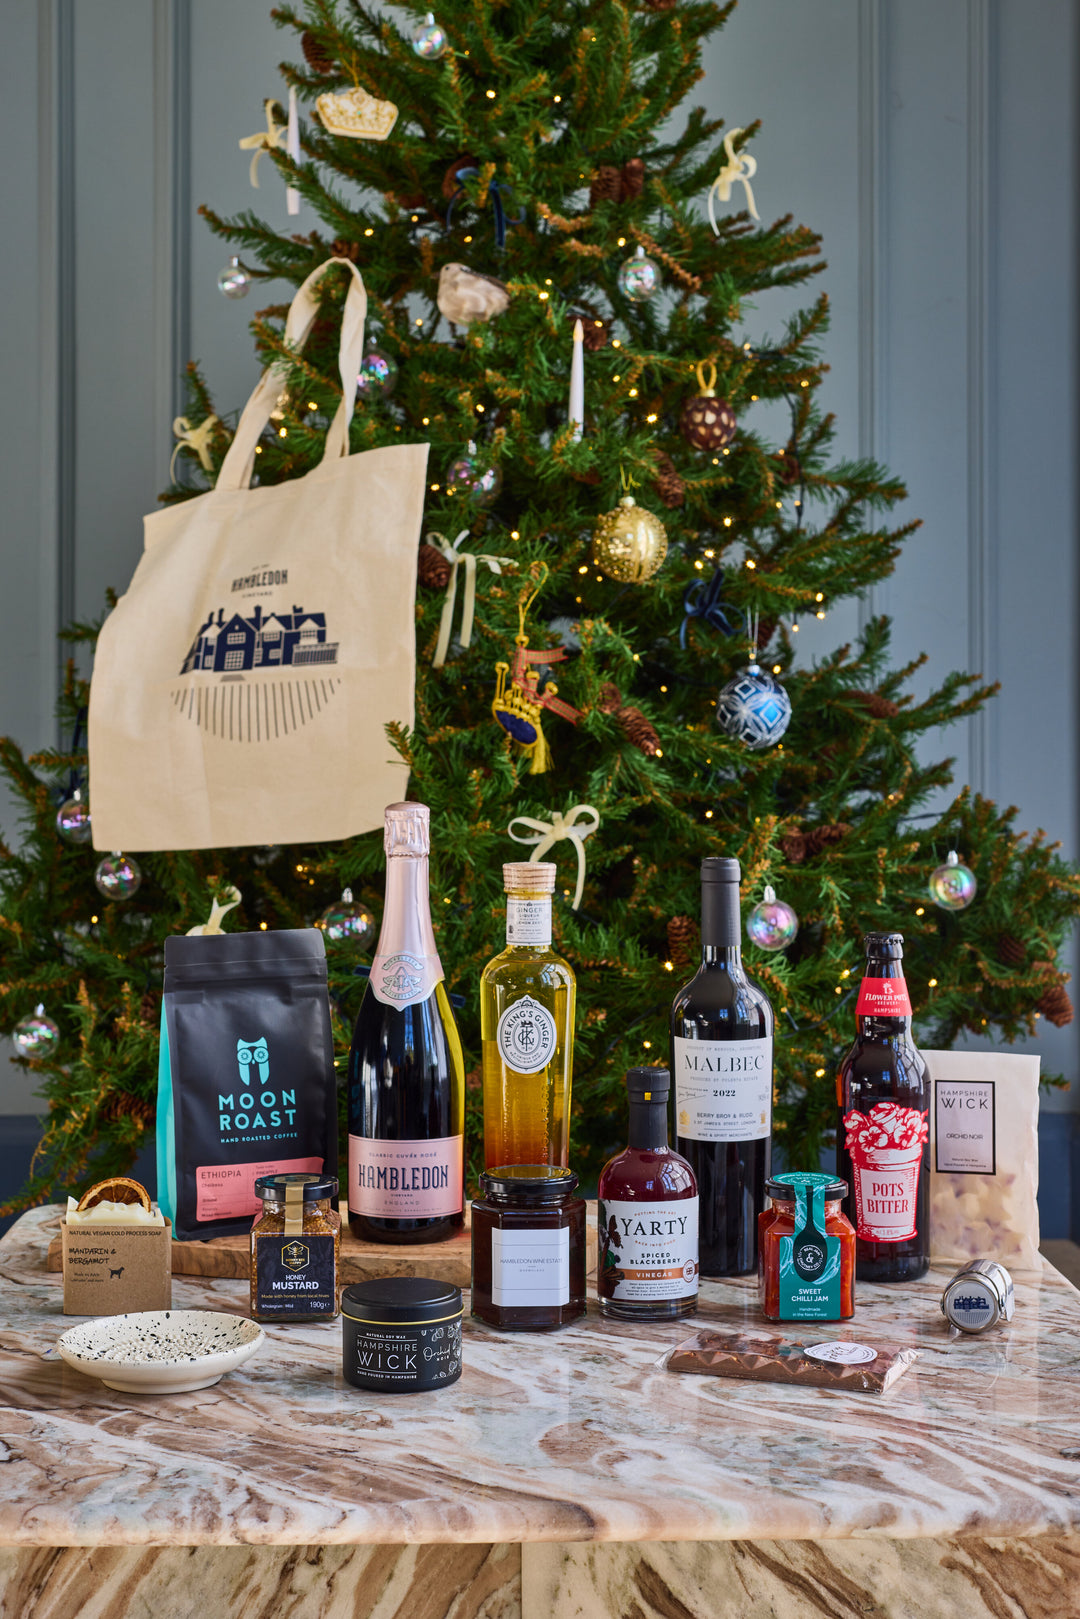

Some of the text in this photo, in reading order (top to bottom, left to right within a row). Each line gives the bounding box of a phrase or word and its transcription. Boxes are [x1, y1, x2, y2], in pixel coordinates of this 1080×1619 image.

[231, 569, 288, 592] HAMBLEDON
[865, 993, 907, 1001] FLOWER POTS
[504, 1010, 549, 1048] THE KING'S GINGER
[684, 1054, 765, 1072] MALBEC
[218, 1089, 297, 1110] MOON
[713, 1089, 737, 1097] 2022
[941, 1098, 989, 1110] WICK
[219, 1109, 297, 1131] ROAST
[242, 1134, 271, 1142] ROASTED
[274, 1132, 298, 1140] COFFEE
[201, 1169, 242, 1179] ETHIOPIA
[358, 1163, 448, 1191] HAMBLEDON
[872, 1182, 904, 1197] POTS
[866, 1198, 909, 1214] BITTER
[620, 1216, 688, 1237] YARTY
[68, 1247, 109, 1255] MANDARIN
[68, 1257, 110, 1266] BERGAMOT
[806, 1252, 814, 1264] &
[636, 1271, 673, 1279] VINEGAR
[272, 1281, 319, 1290] MUSTARD
[310, 1300, 324, 1310] 190g
[357, 1339, 417, 1352] HAMPSHIRE
[423, 1343, 451, 1361] Orchid
[357, 1350, 417, 1370] WICK
